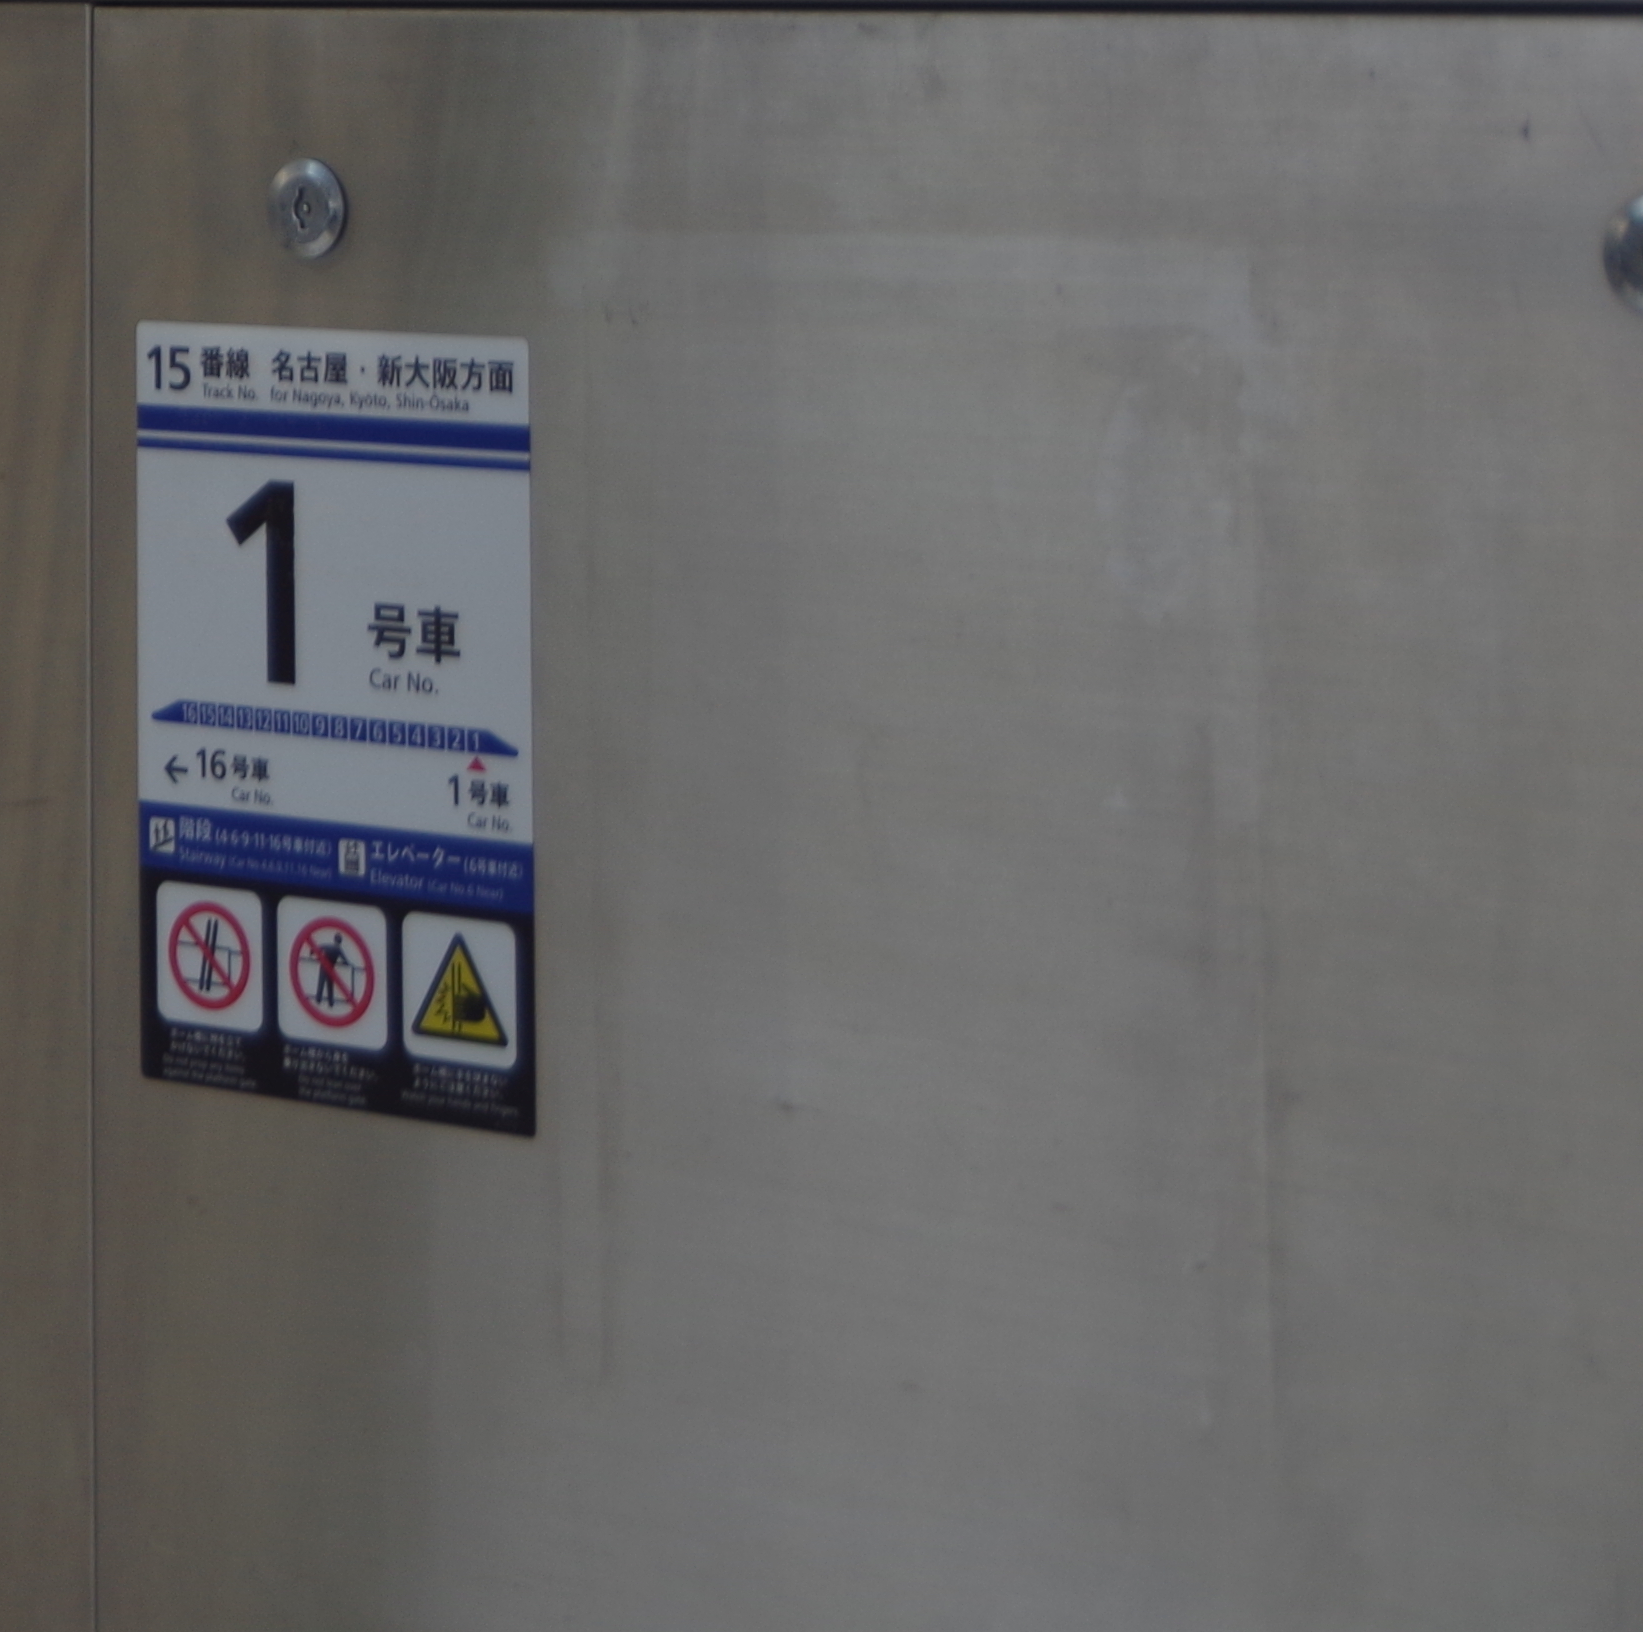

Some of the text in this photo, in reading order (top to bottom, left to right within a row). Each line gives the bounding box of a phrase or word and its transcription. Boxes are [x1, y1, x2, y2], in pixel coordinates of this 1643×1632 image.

[202, 383, 234, 400] Track
[237, 385, 259, 401] No.
[270, 385, 290, 402] for
[292, 387, 345, 407] Nagoya,
[226, 479, 461, 685] 1 号車
[369, 668, 439, 695] Car No.
[231, 786, 274, 806] Car No.
[179, 814, 212, 842] 階段
[467, 811, 513, 834] Car No.
[370, 839, 462, 870] エレベーター
[370, 866, 425, 889] Elevator
